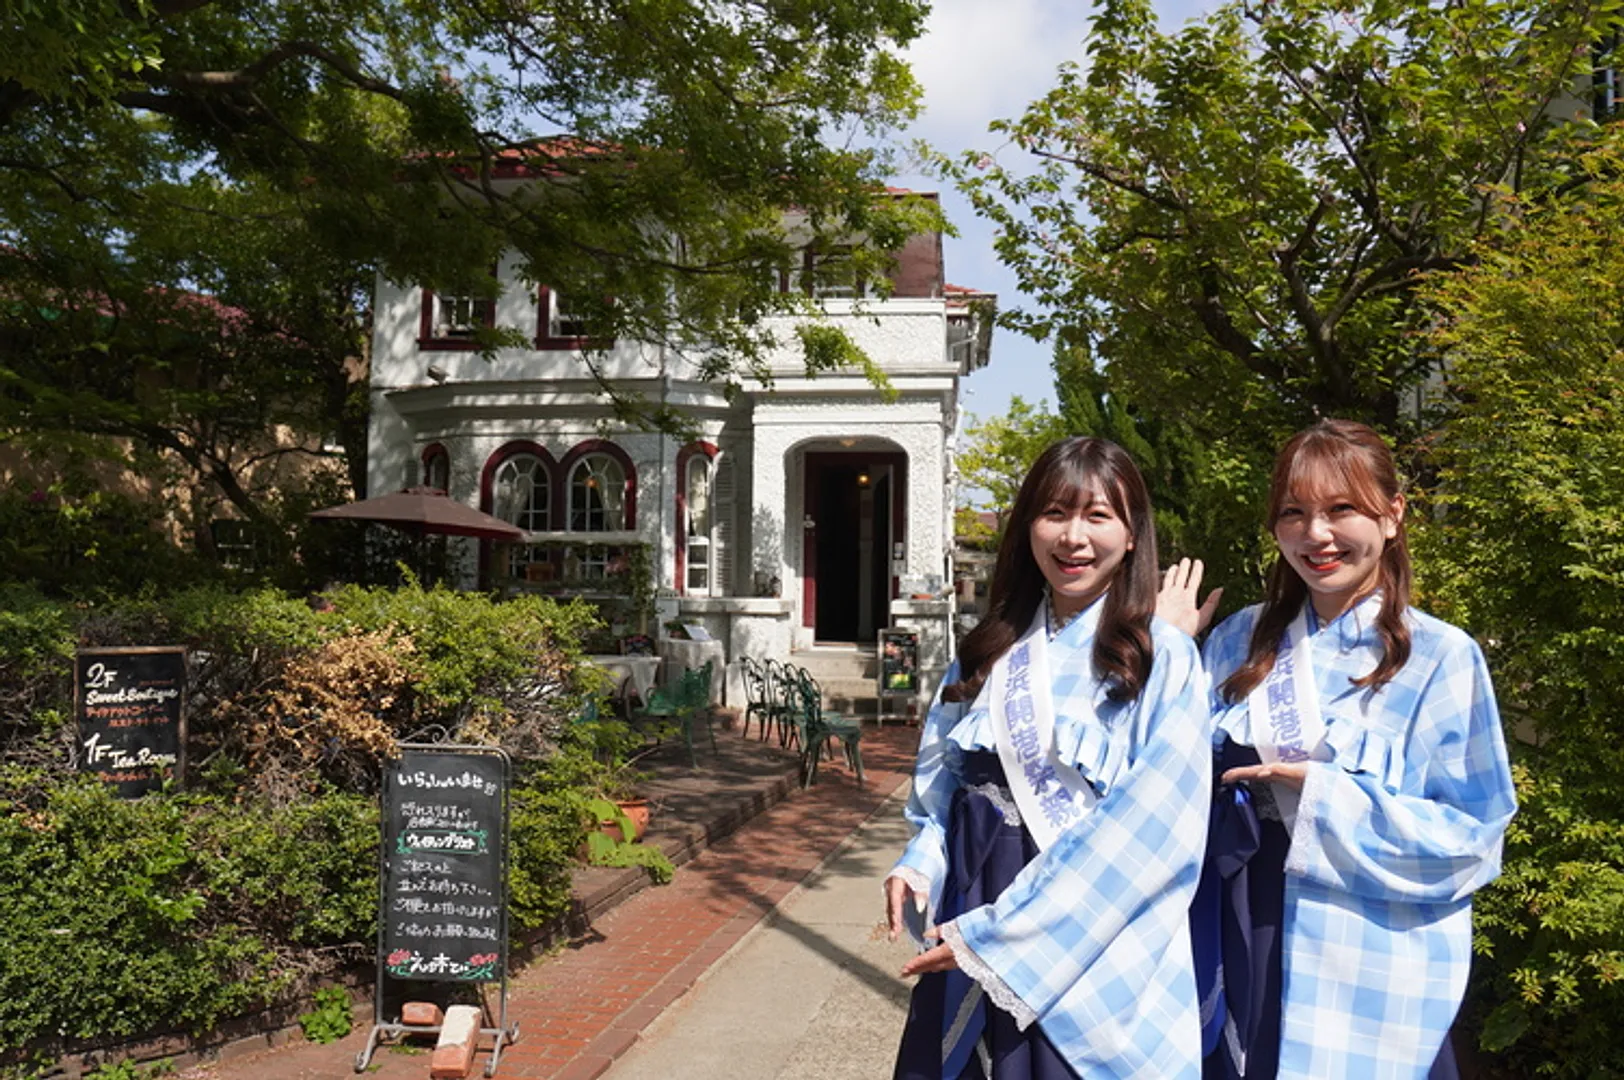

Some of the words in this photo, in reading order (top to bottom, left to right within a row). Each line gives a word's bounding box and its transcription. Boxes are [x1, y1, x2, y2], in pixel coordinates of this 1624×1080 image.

[85, 663, 117, 688] 2F
[86, 687, 124, 704] Sweet
[84, 732, 111, 764] 1F
[108, 750, 137, 768] Tea
[410, 952, 469, 974] えの木てい
